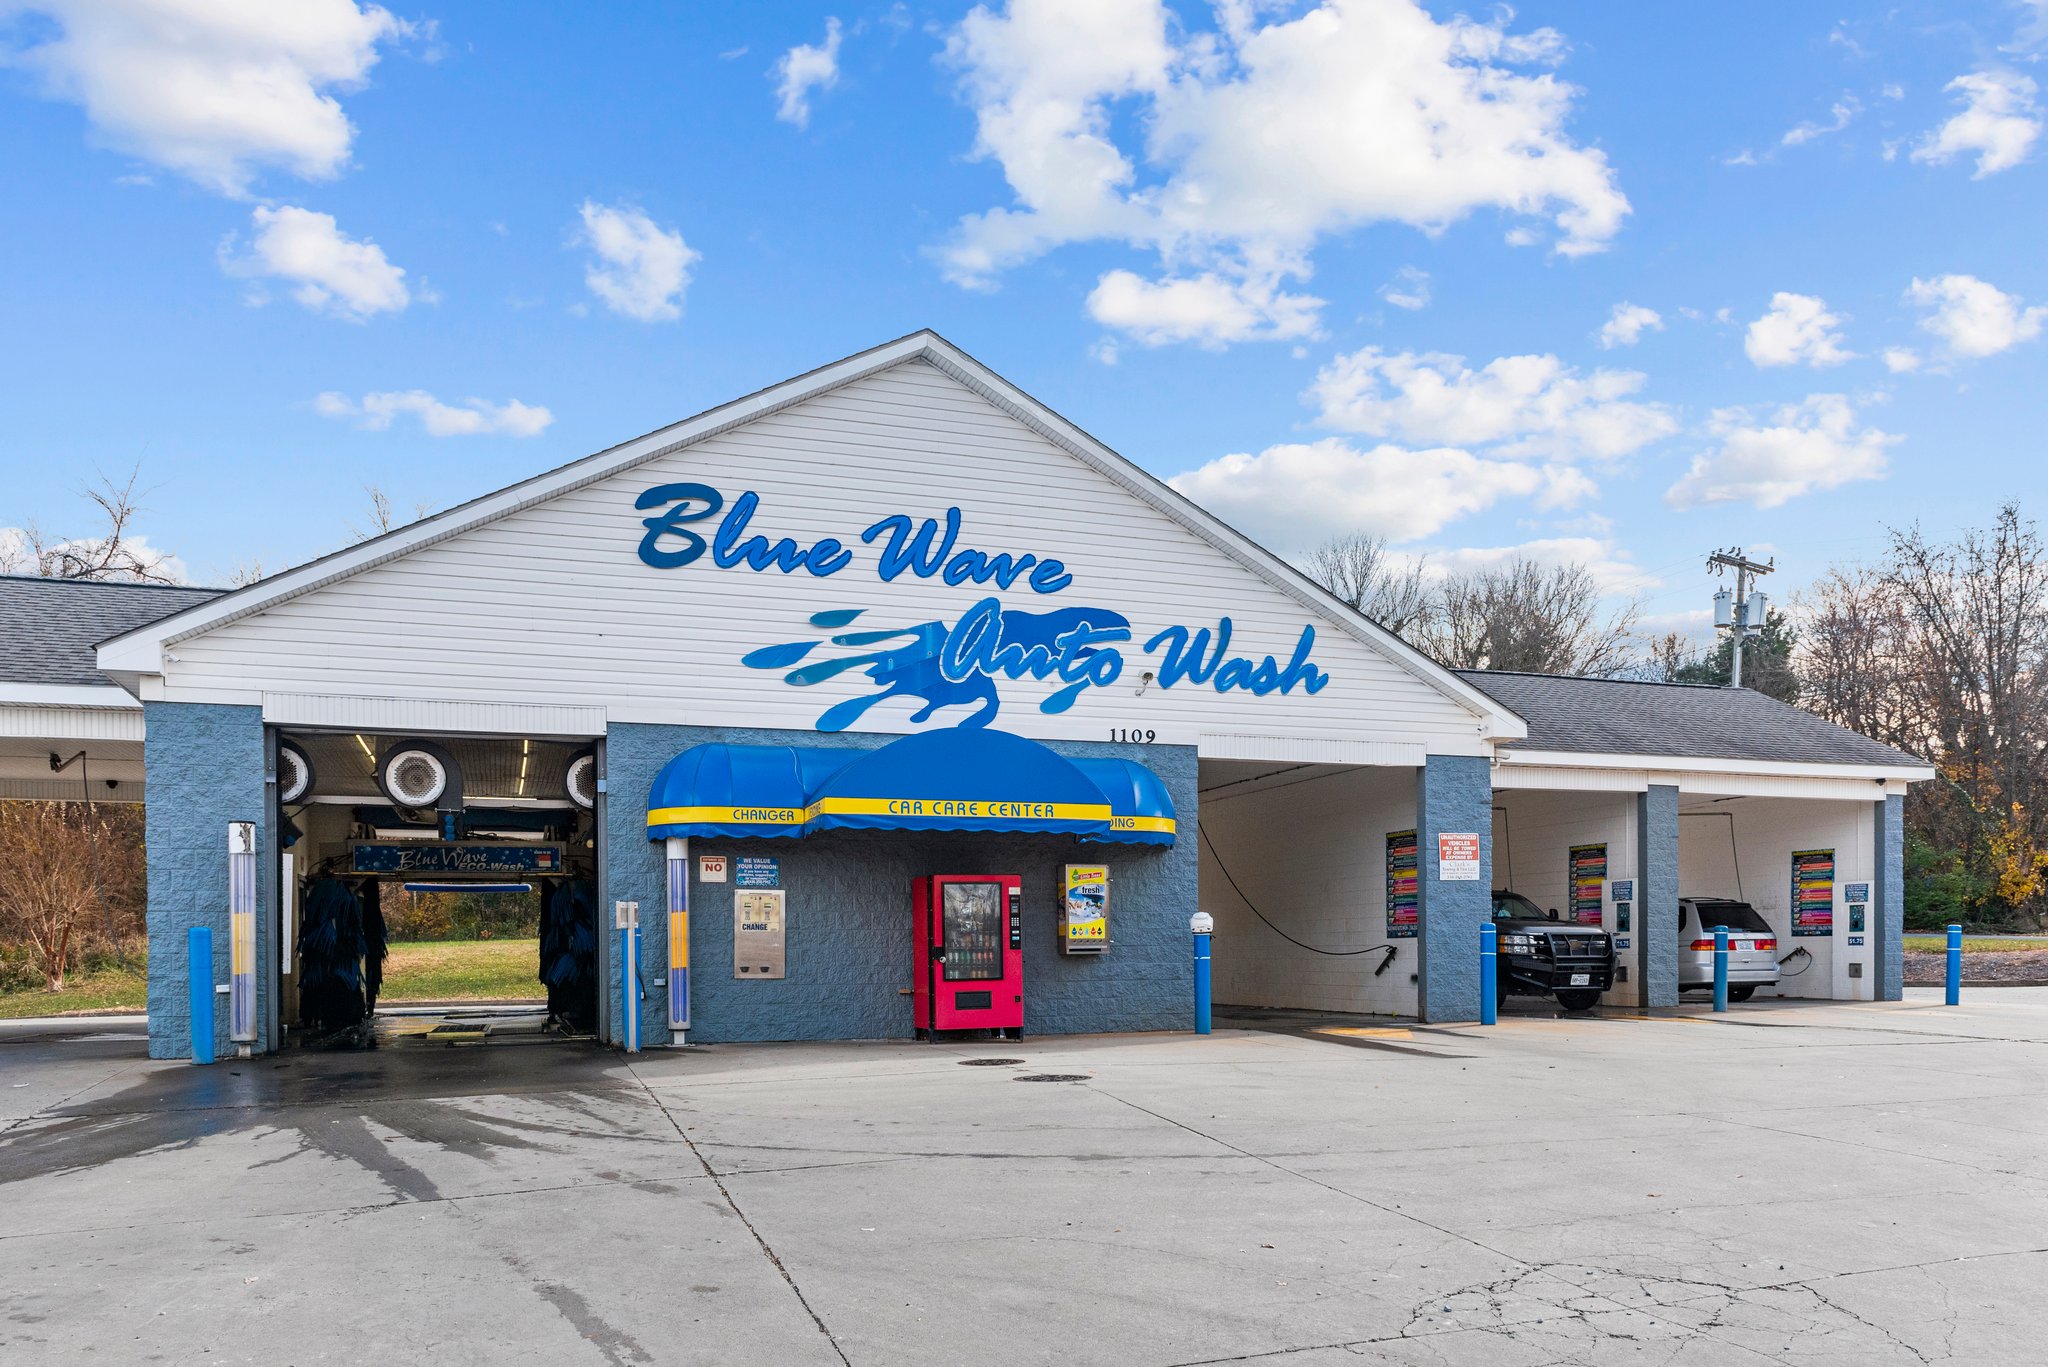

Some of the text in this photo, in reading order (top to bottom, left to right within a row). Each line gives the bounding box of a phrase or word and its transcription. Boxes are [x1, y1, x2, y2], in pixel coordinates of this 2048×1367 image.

[635, 482, 1072, 594] Blue Wave
[940, 597, 1329, 697] Auto Wash
[1110, 728, 1156, 744] 1109
[733, 809, 795, 821] CHANGER
[889, 801, 1055, 817] CAR CARE CENTER
[396, 846, 488, 870] Blue Wave
[458, 861, 525, 871] ECO-Wash
[705, 863, 723, 872] NO
[1082, 886, 1100, 894] fresh
[742, 923, 768, 931] CHANGE
